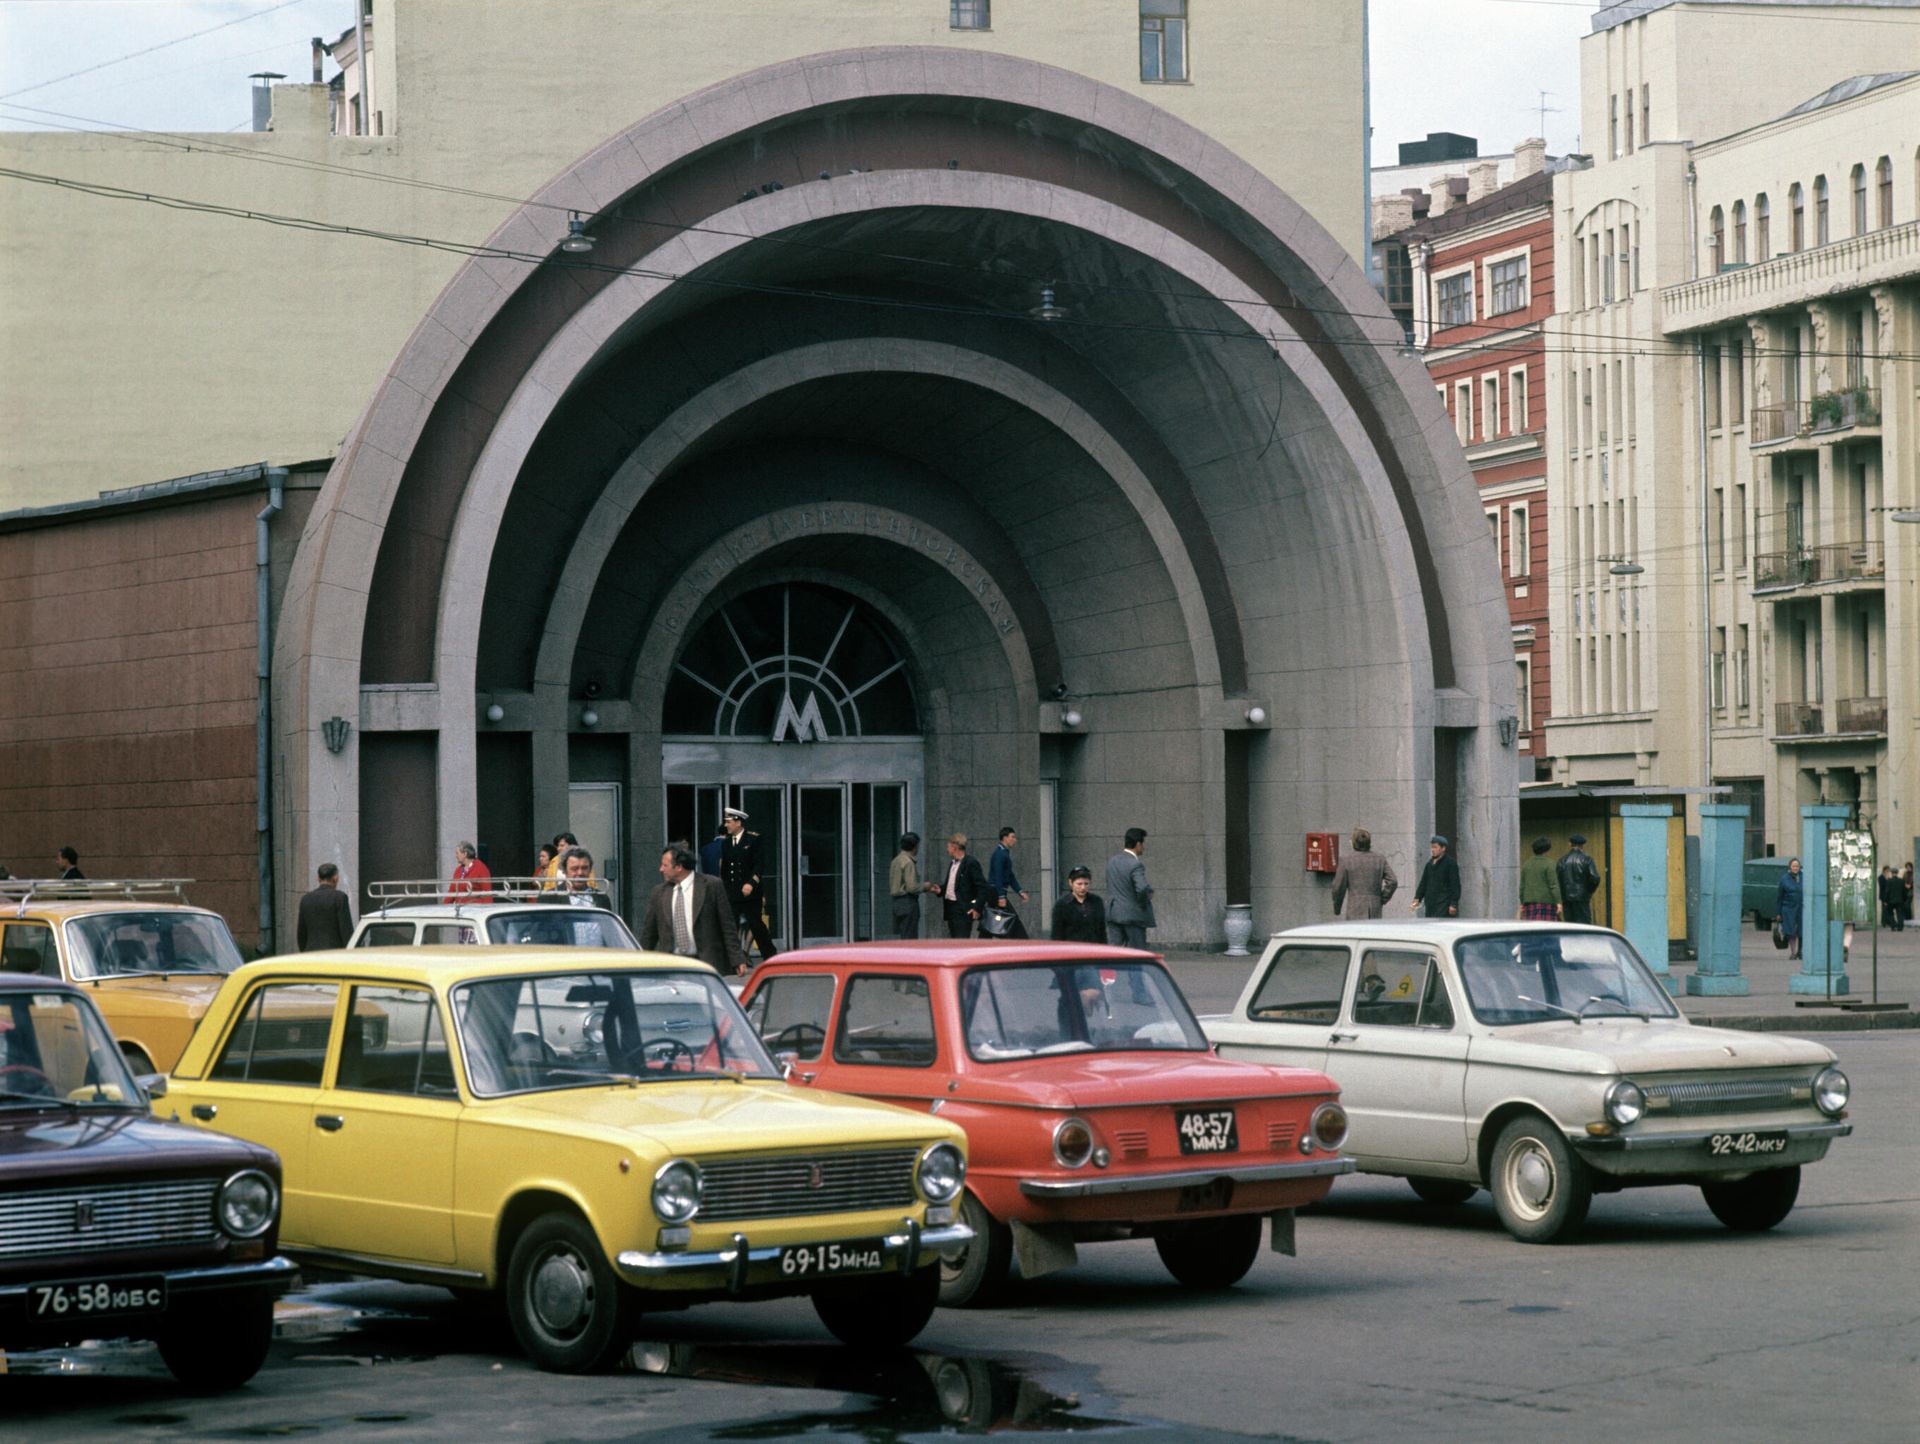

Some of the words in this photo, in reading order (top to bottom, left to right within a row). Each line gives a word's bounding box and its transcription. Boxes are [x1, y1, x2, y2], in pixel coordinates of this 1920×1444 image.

[778, 509, 1016, 636] ЛЕРМОНТОВСКАЯ
[773, 691, 828, 743] М
[1181, 1112, 1232, 1137] 48-57
[1192, 1136, 1227, 1150] ММУ
